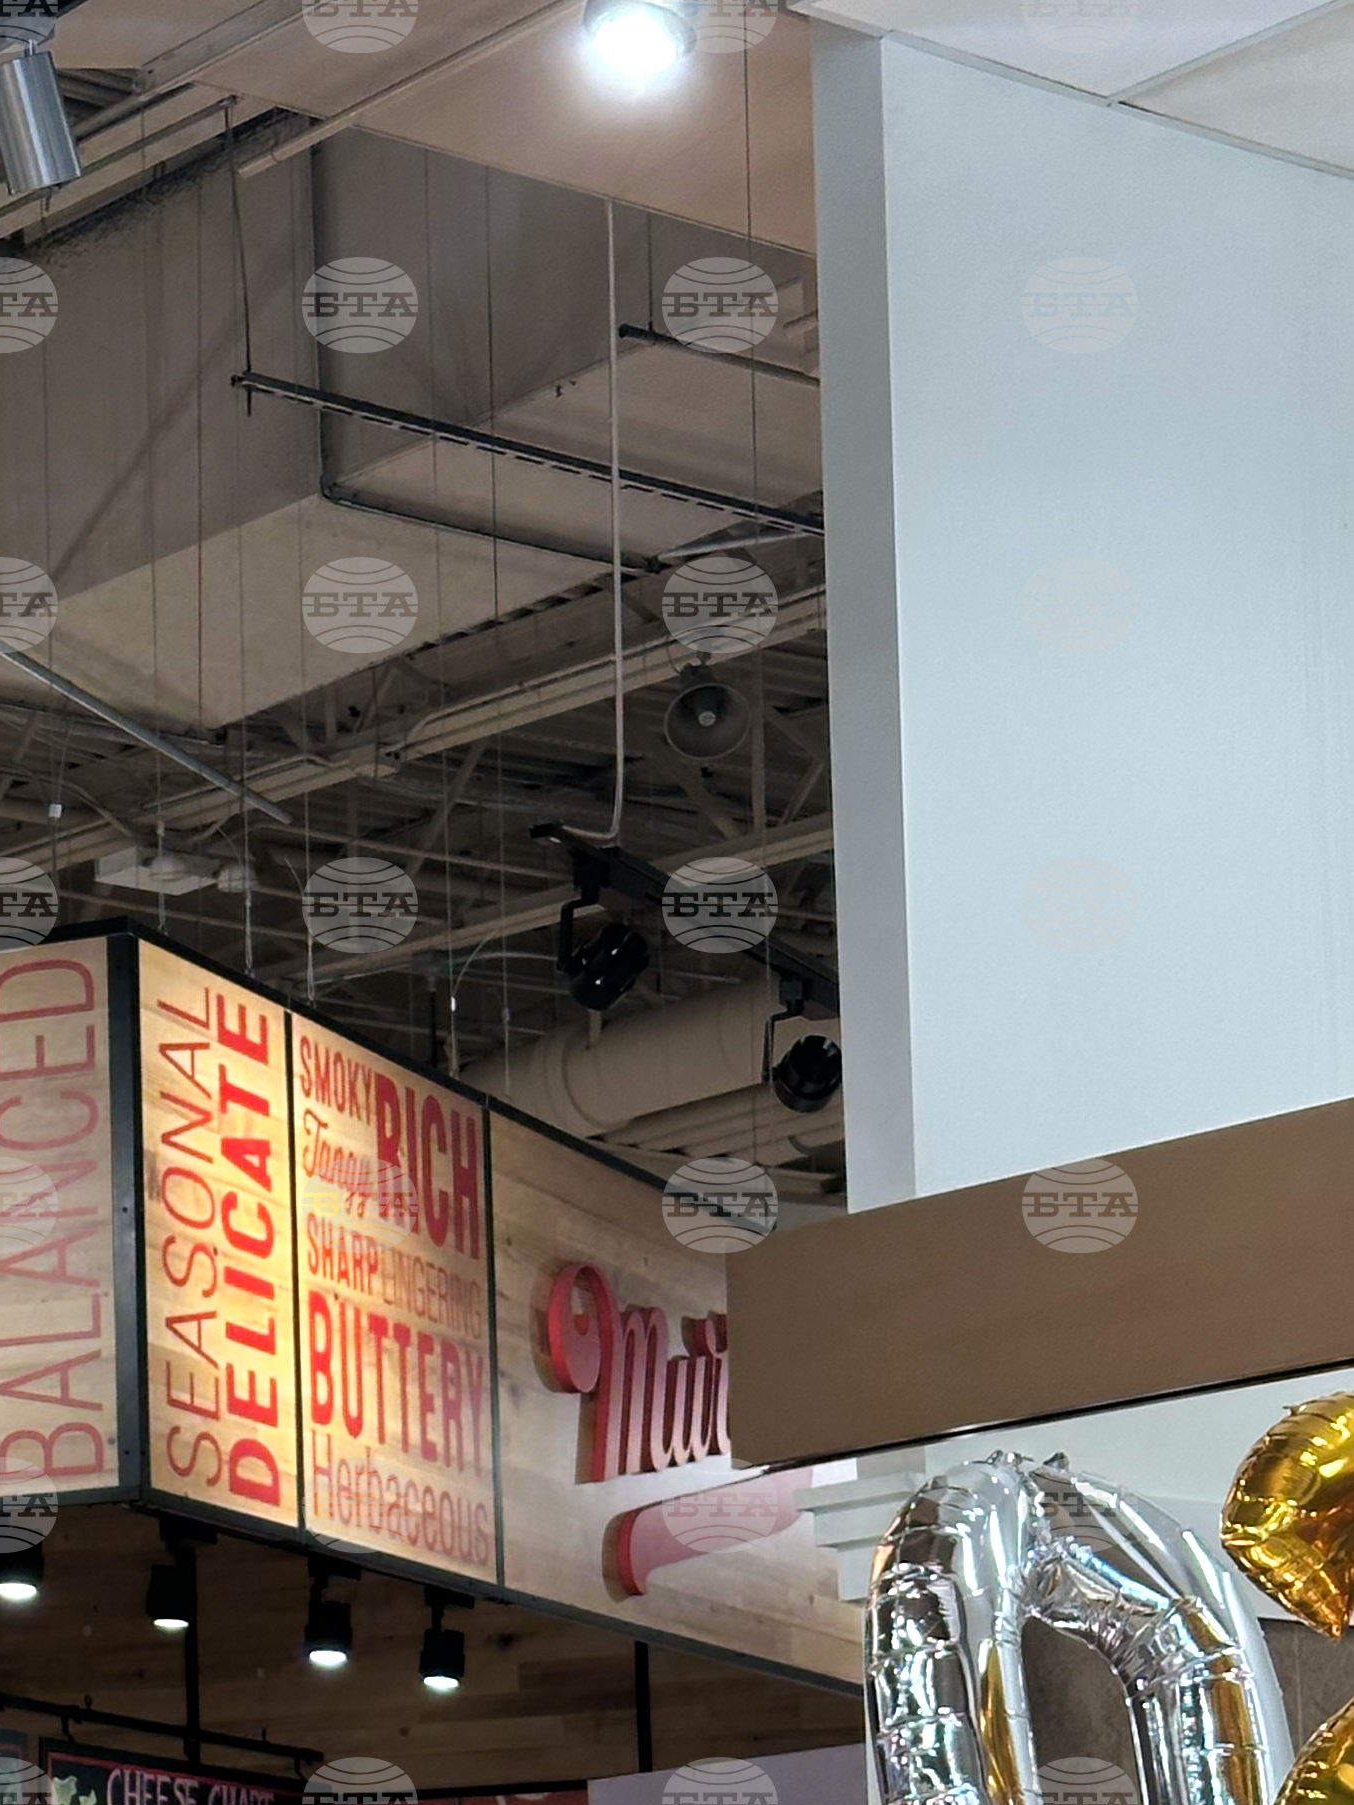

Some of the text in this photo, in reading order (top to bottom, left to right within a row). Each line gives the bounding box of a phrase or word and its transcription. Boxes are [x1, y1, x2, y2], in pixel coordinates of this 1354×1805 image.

[300, 1035, 375, 1126] SMOKY
[375, 1073, 480, 1261] RICH
[157, 986, 223, 1488] SEASONAL
[216, 993, 280, 1507] DELICATE
[307, 1212, 381, 1296] SHARP
[309, 1290, 484, 1478] BUTTERY
[312, 1429, 489, 1566] Herbaceous
